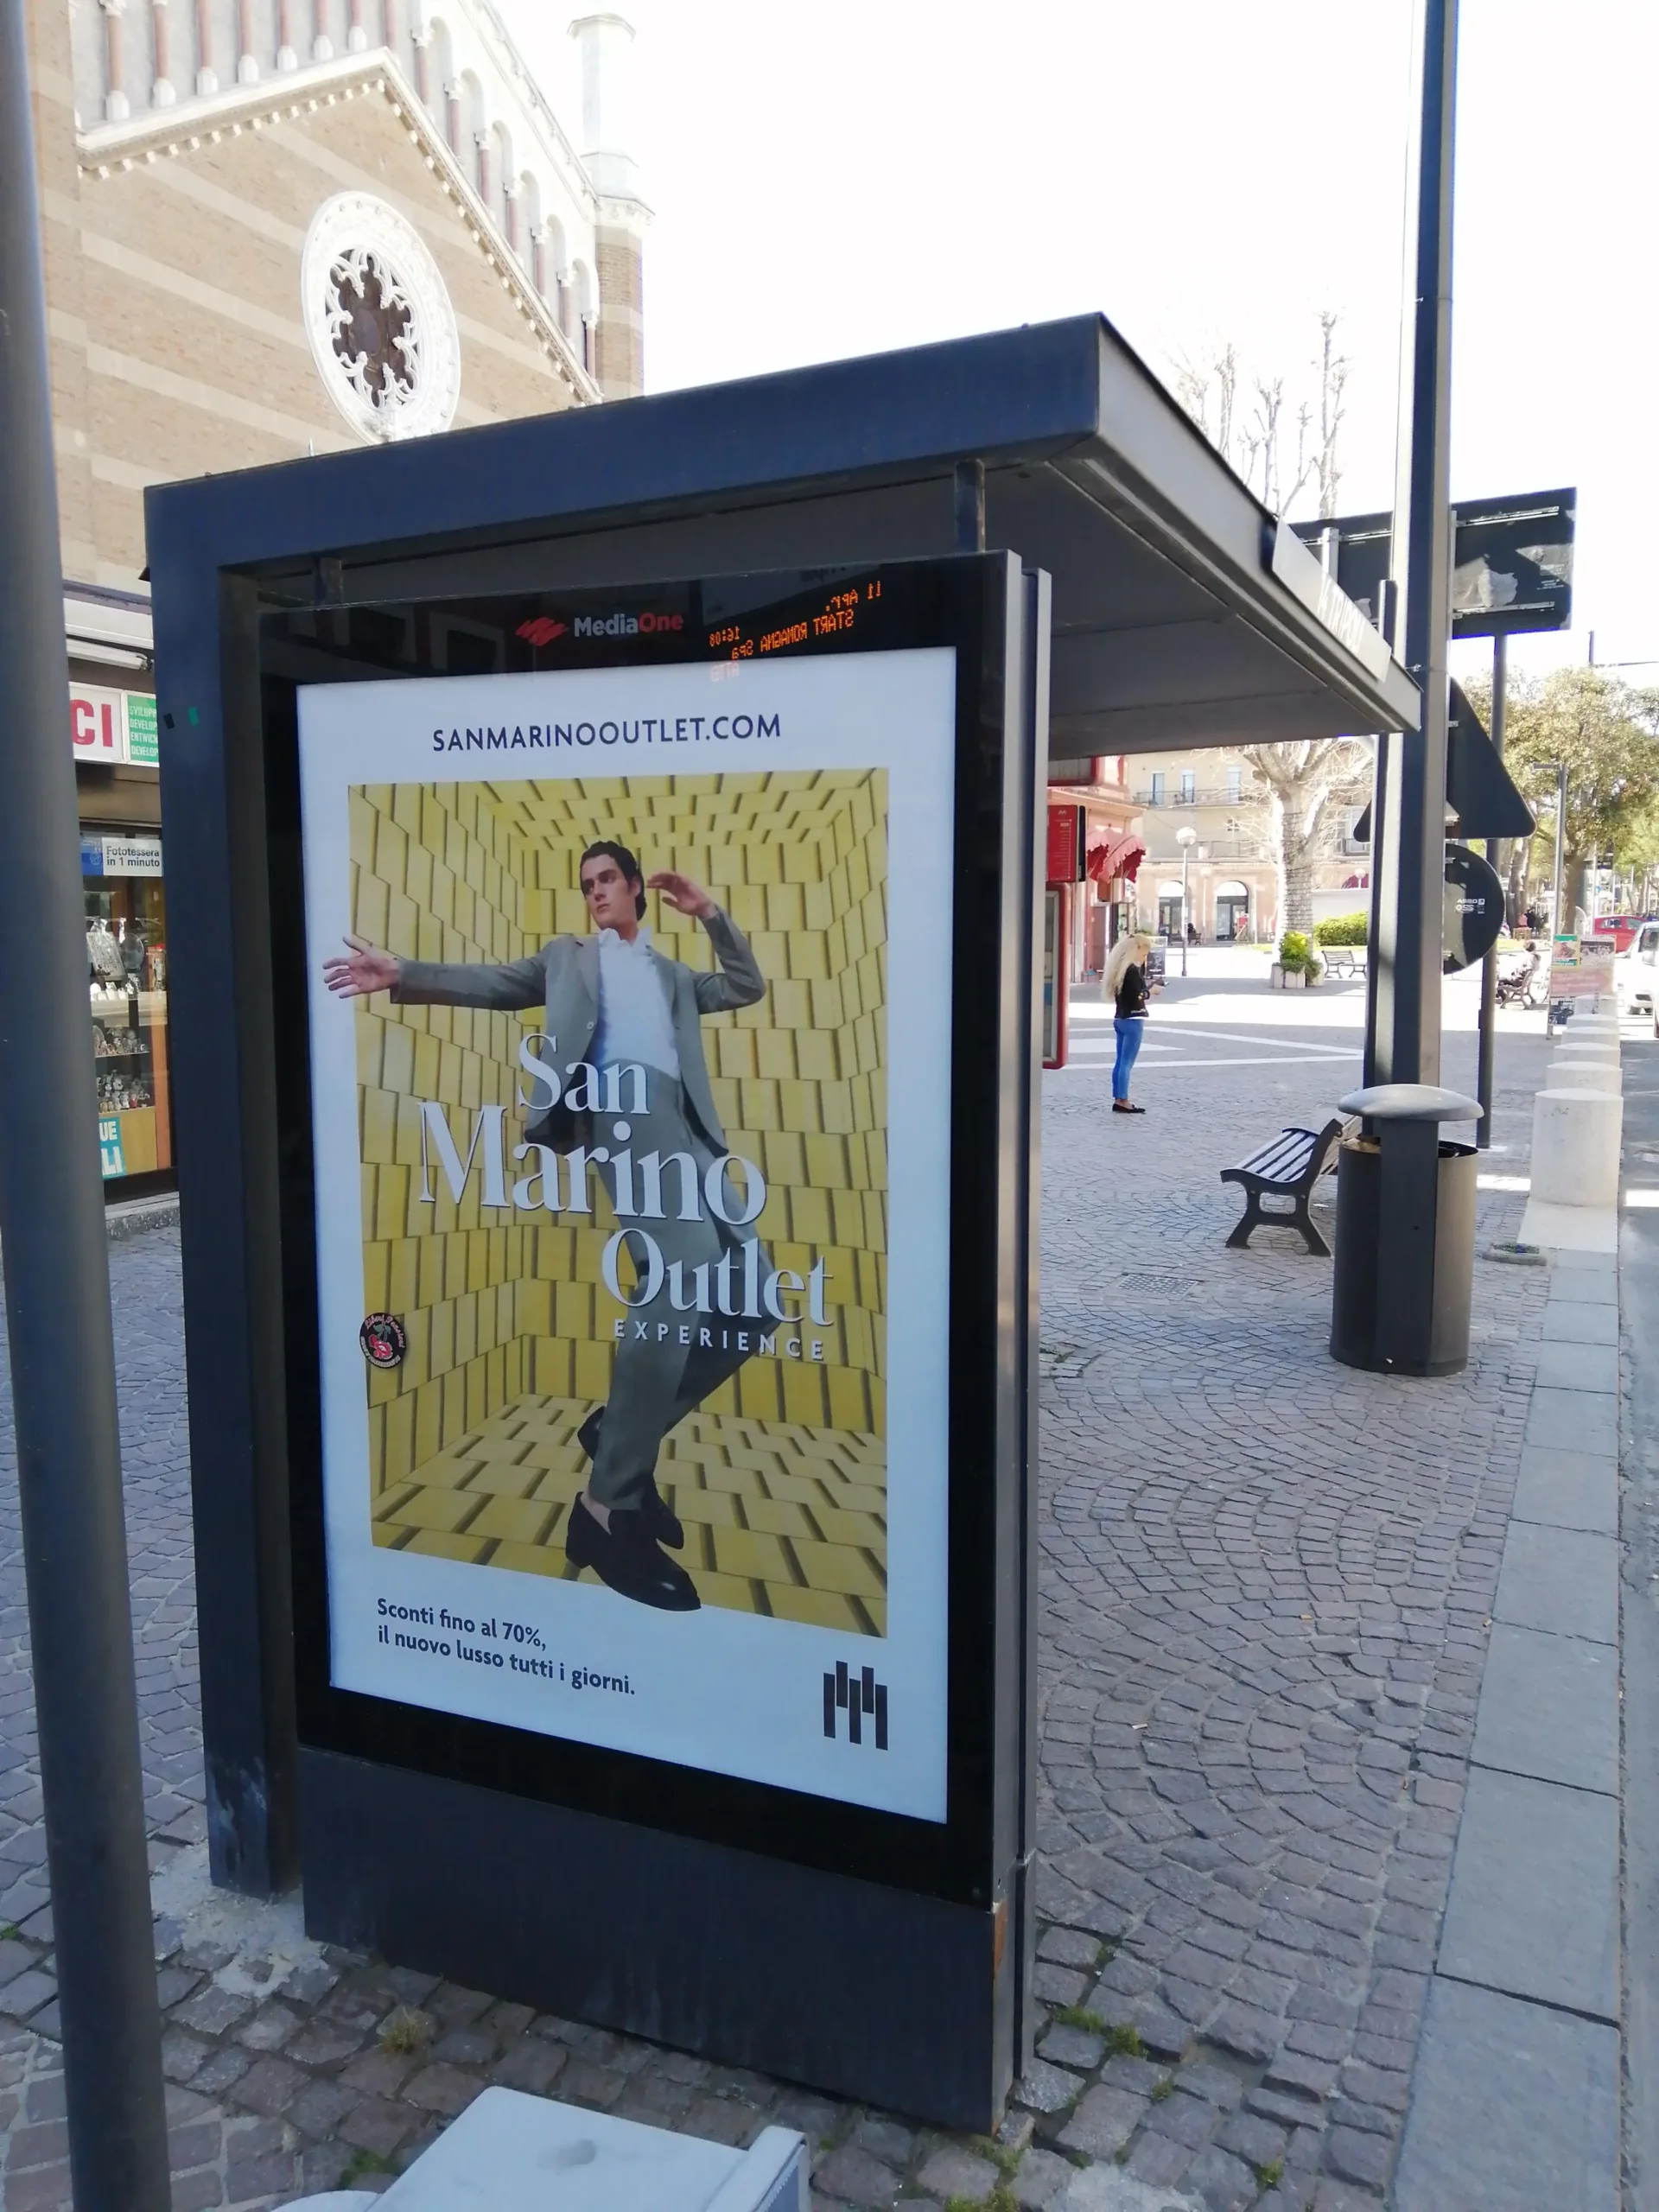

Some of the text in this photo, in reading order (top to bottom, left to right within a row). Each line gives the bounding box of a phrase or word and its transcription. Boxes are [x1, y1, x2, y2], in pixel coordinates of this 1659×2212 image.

[574, 613, 683, 638] MediaOne
[433, 714, 781, 752] SANMARINOOUTLET.COM
[106, 846, 160, 857] Fototessera
[106, 856, 160, 868] in 1 minuto
[518, 1033, 651, 1116] San
[101, 1146, 123, 1176] LI
[418, 1101, 767, 1225] Marino
[601, 1228, 834, 1327] Outlet
[614, 1319, 824, 1360] EXPERIENCE
[378, 1599, 546, 1651] Sconti fino al 70%,
[378, 1625, 636, 1695] il nuovo lusso tutti i giorni.
